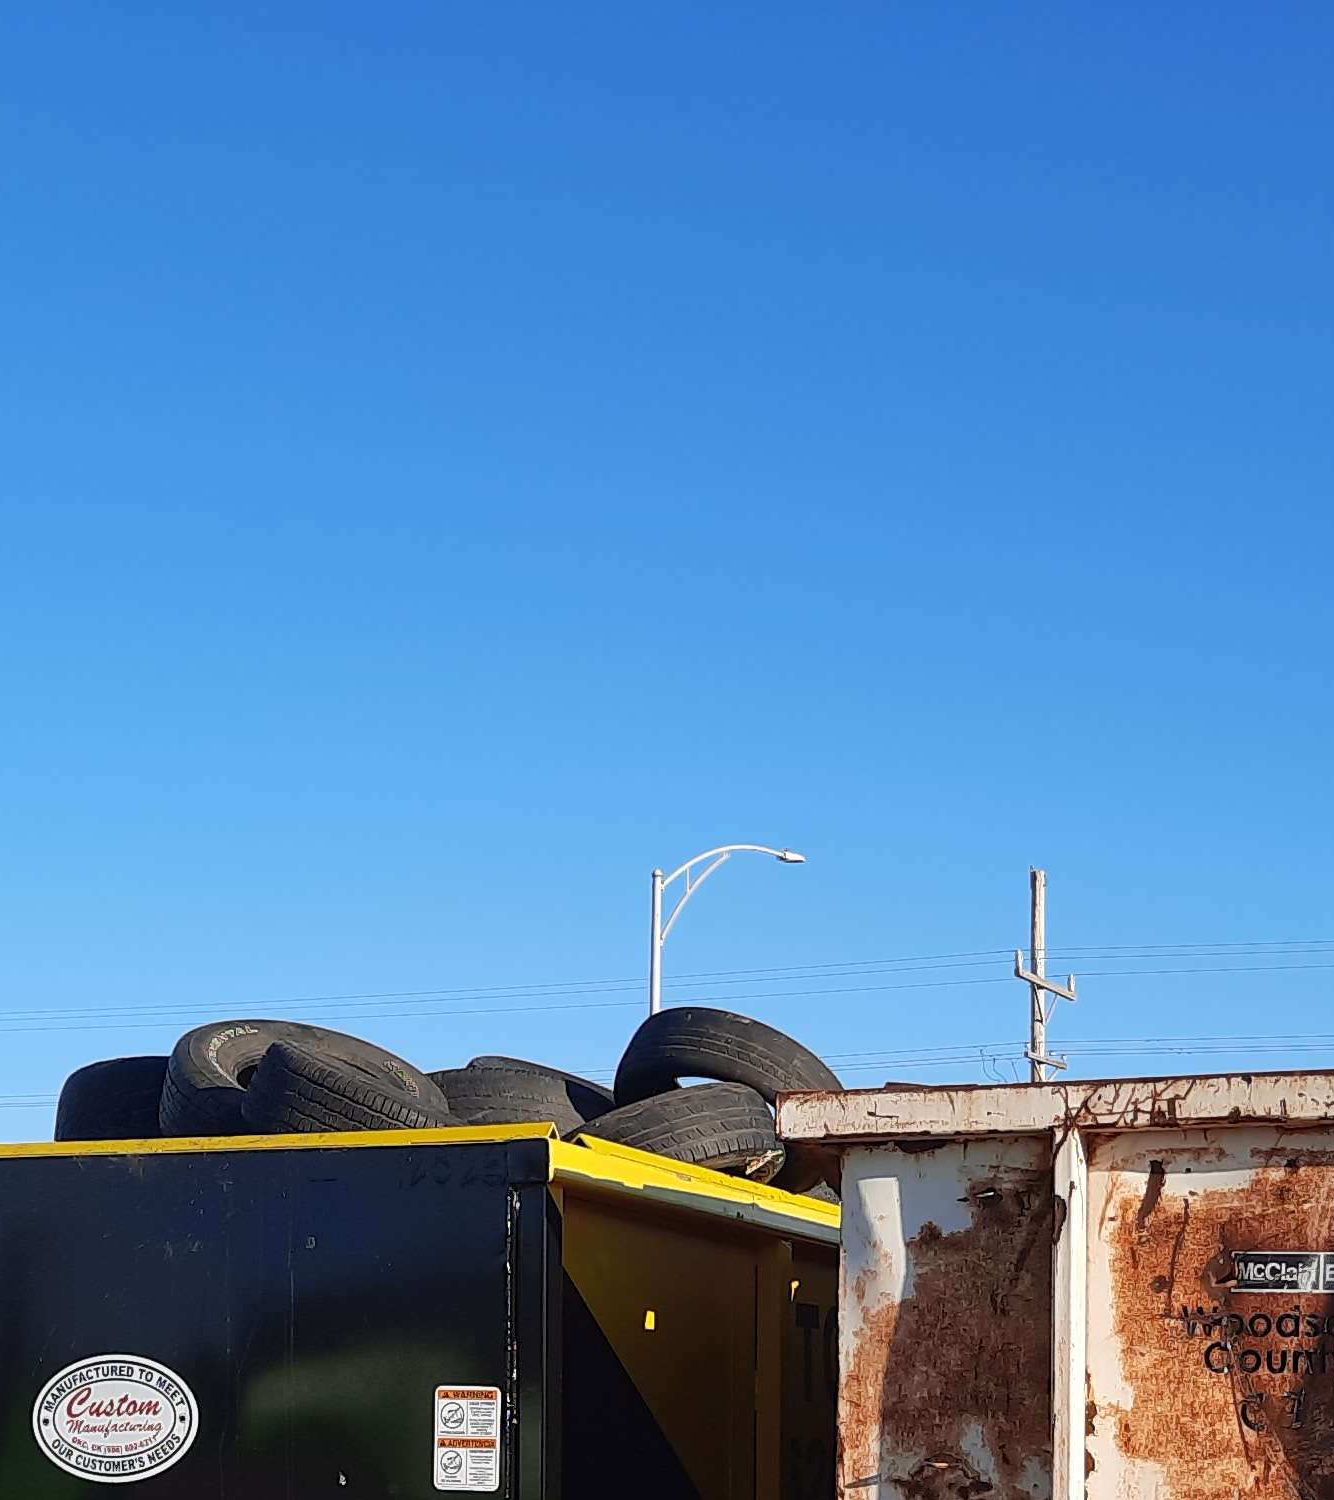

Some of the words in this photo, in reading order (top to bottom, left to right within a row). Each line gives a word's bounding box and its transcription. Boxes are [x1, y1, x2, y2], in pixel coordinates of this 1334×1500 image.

[44, 1365, 134, 1412] MANUFACTURED
[138, 1367, 154, 1383] TO
[156, 1376, 186, 1407] MEET
[66, 1386, 163, 1419] Custom
[66, 1419, 163, 1438] Manufacturing
[51, 1437, 73, 1459] OUR
[75, 1454, 145, 1472] CUSTOMER'S
[148, 1433, 181, 1465] NEEDS
